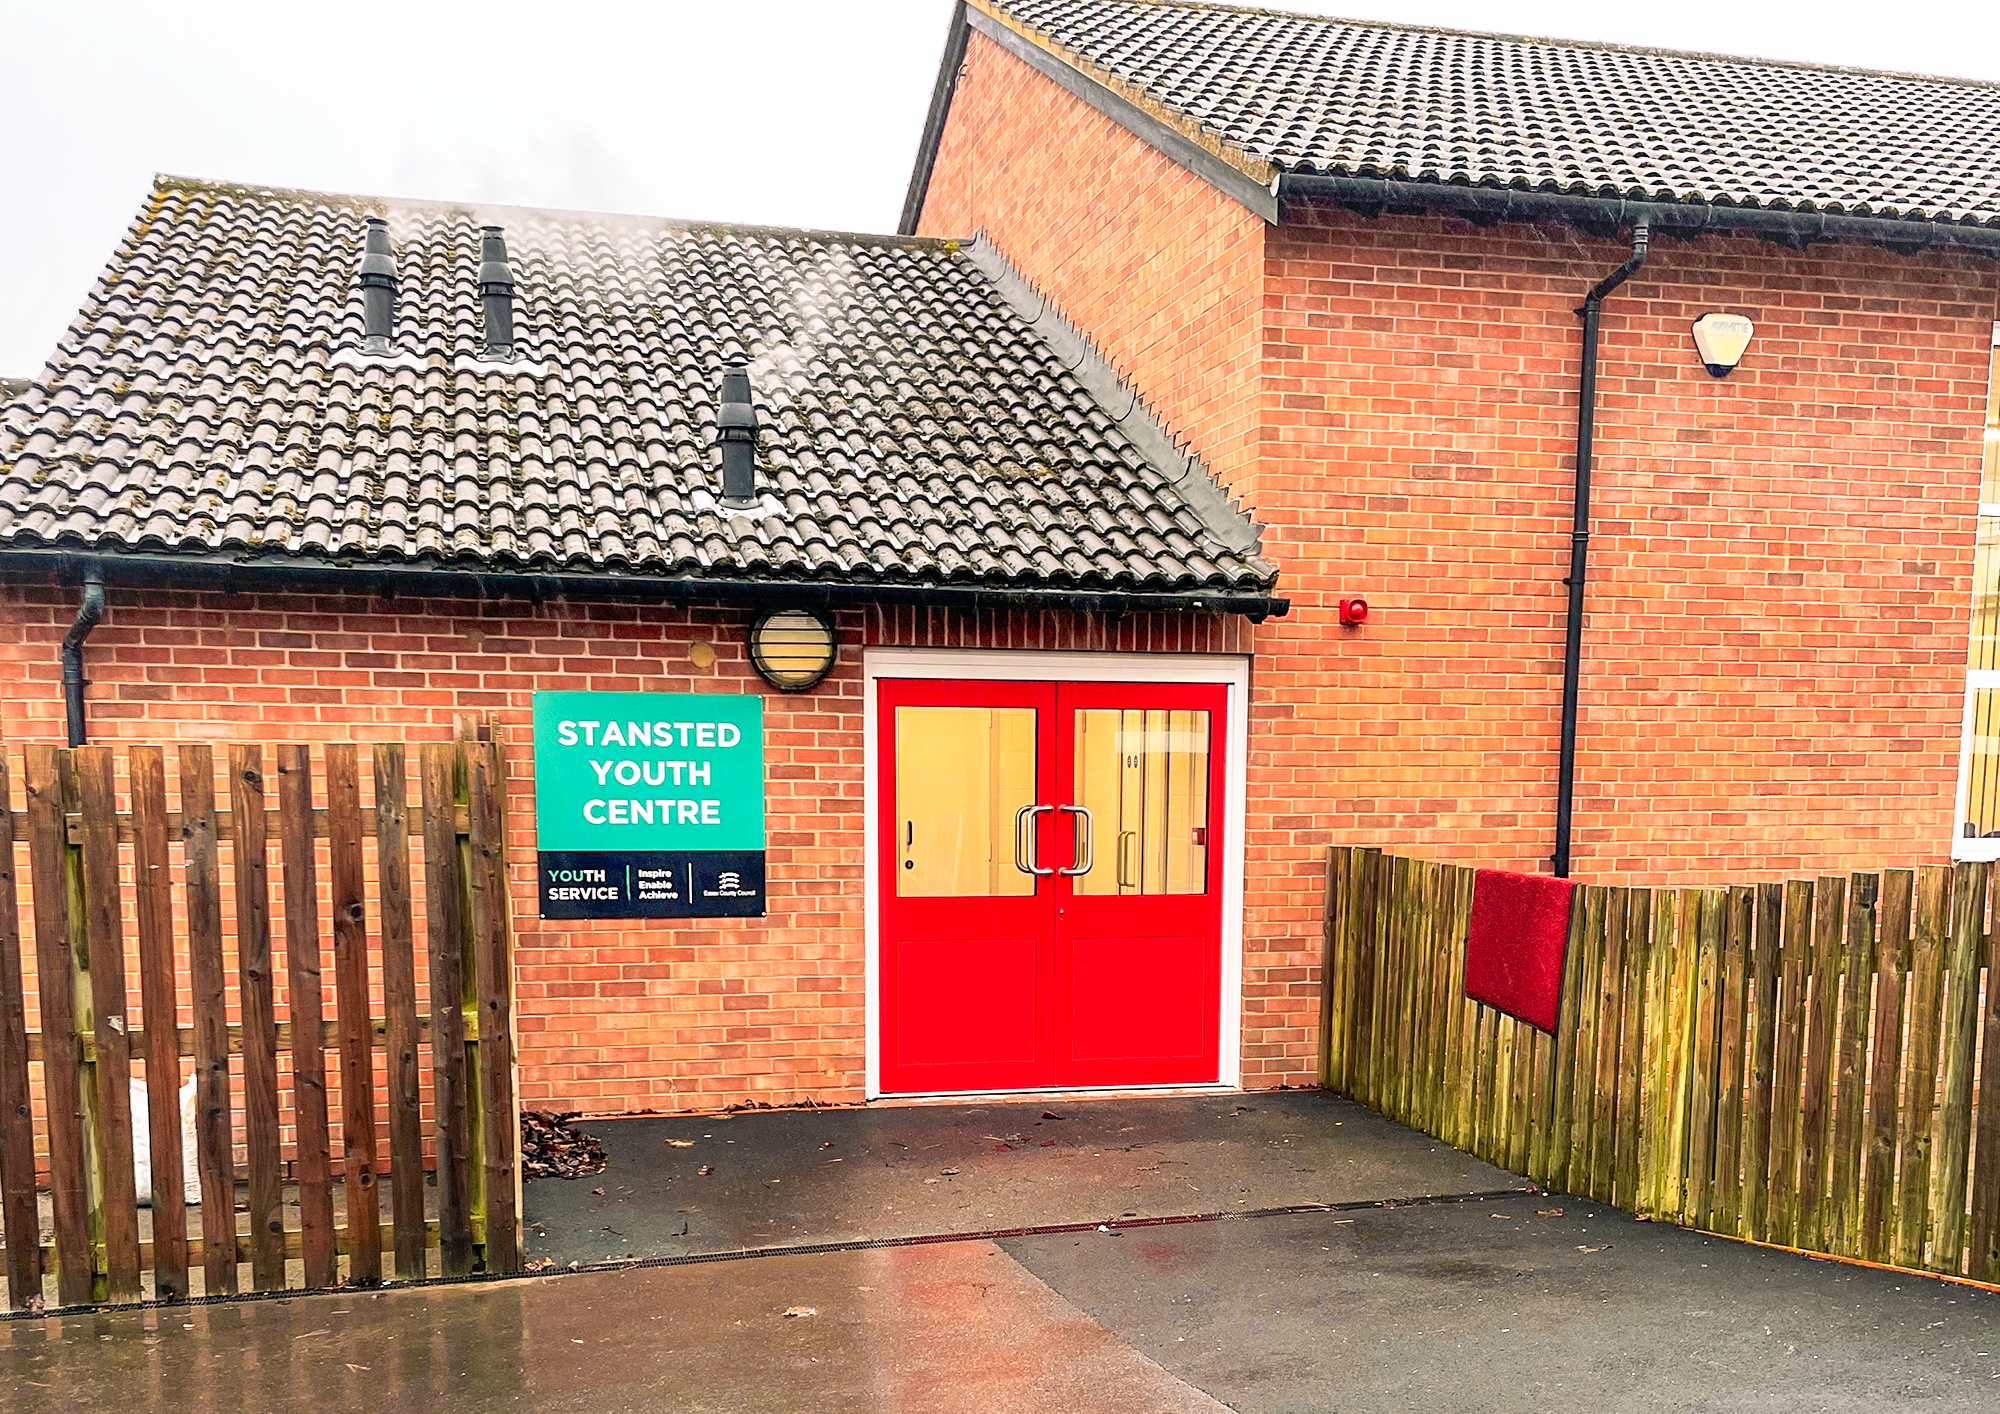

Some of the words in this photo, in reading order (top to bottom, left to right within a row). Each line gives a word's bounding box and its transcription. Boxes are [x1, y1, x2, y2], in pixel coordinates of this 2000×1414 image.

[558, 720, 741, 748] STANSTED
[589, 760, 711, 786] YOUTH
[583, 799, 721, 825] CENTRE
[548, 869, 606, 882] YOUTH
[637, 869, 672, 879] Inspire
[638, 880, 673, 889] Enable
[548, 887, 619, 900] SERVICE
[638, 891, 679, 900] Achieve
